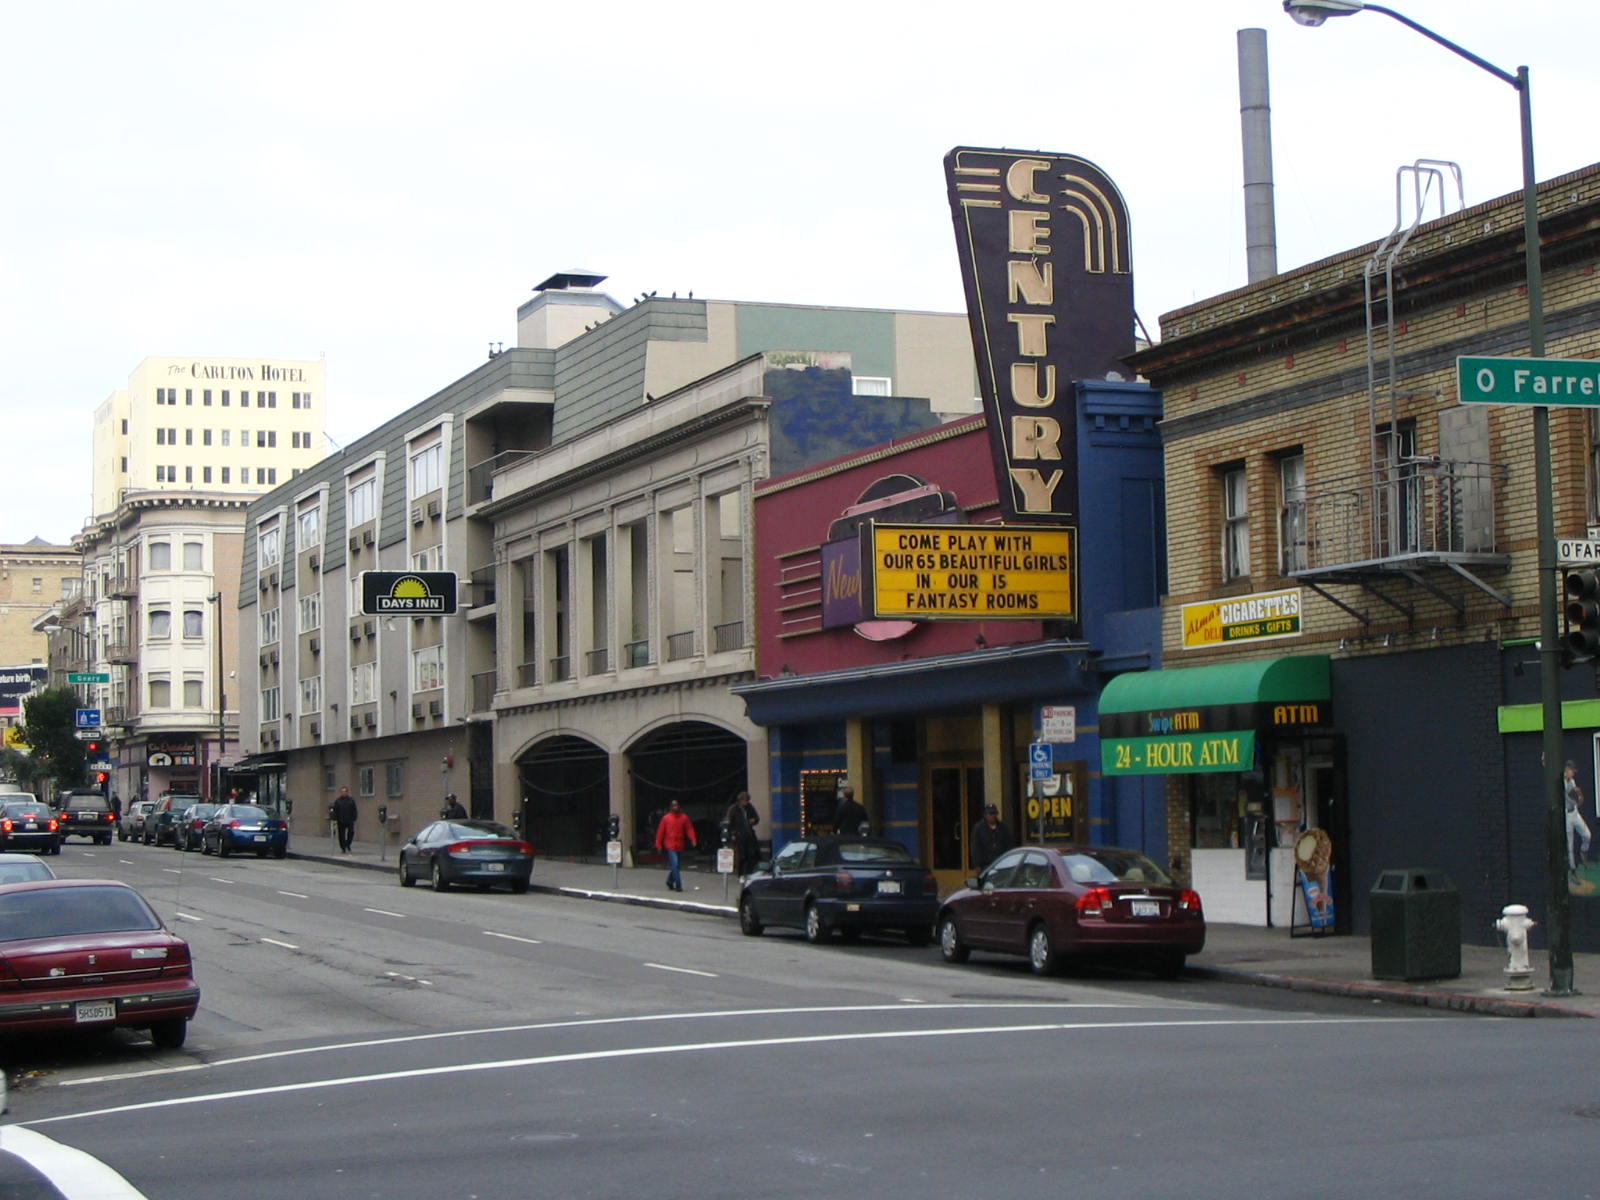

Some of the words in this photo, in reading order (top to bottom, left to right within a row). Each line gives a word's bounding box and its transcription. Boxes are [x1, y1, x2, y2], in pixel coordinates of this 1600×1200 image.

[1006, 158, 1064, 512] CENTURY
[167, 364, 186, 376] The
[1476, 368, 1495, 392] O
[899, 534, 940, 550] COME
[948, 535, 987, 551] PLAY
[994, 536, 1031, 552] WITH
[884, 553, 913, 570] OUR
[917, 554, 935, 569] 65
[940, 554, 1021, 570] BEAUTIFUL
[1023, 555, 1067, 571] GIRLS
[916, 573, 930, 588] IN
[948, 573, 978, 589] OUR
[381, 599, 414, 608] DAYS
[416, 599, 439, 608] INN
[907, 592, 978, 608] FANTASY
[986, 593, 1038, 609] ROOMS
[1221, 594, 1298, 624] CIGARETTES
[1229, 624, 1260, 637] DRINKS
[1267, 620, 1292, 633] GIFTS
[1274, 705, 1319, 724] ATM
[1199, 738, 1239, 766] ATM
[1028, 797, 1072, 819] OPEN
